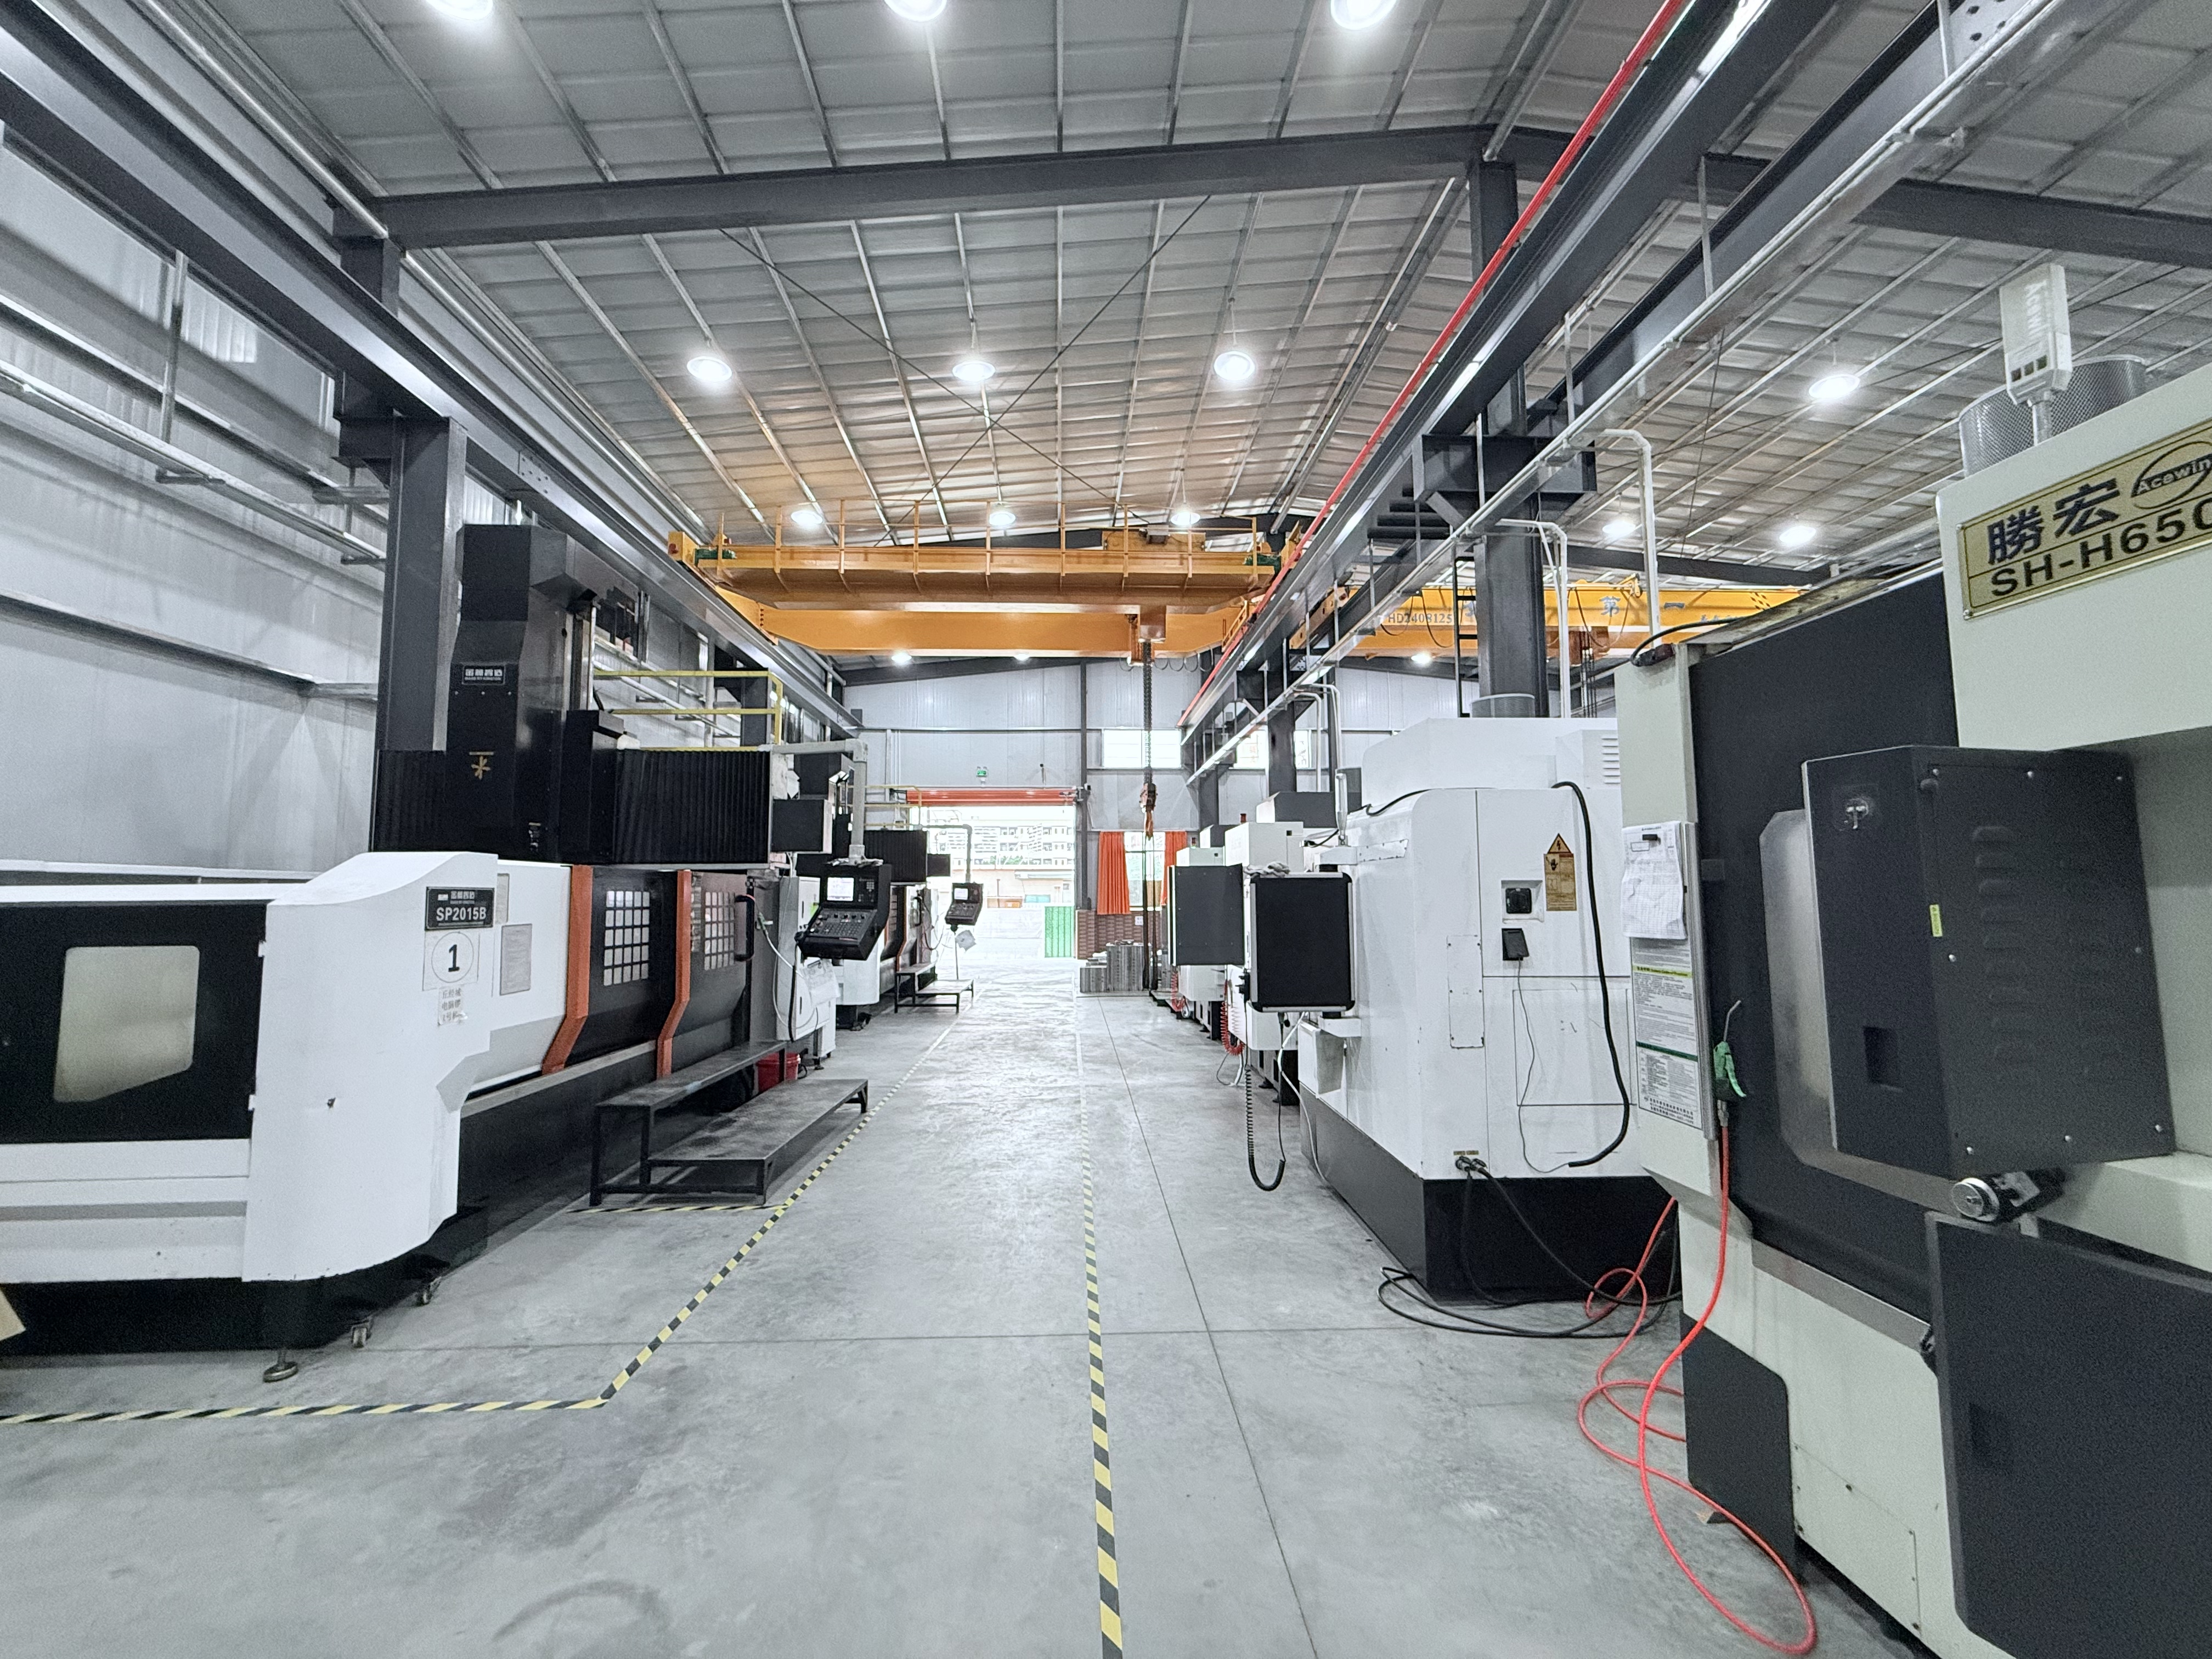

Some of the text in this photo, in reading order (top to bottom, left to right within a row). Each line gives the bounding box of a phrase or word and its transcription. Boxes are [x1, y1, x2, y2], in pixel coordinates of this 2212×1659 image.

[2138, 459, 2211, 493] Acewin
[1987, 478, 2121, 565] 勝宏
[1387, 613, 1453, 624] HD2408125
[436, 906, 487, 921] SP2015B
[448, 944, 460, 973] 1
